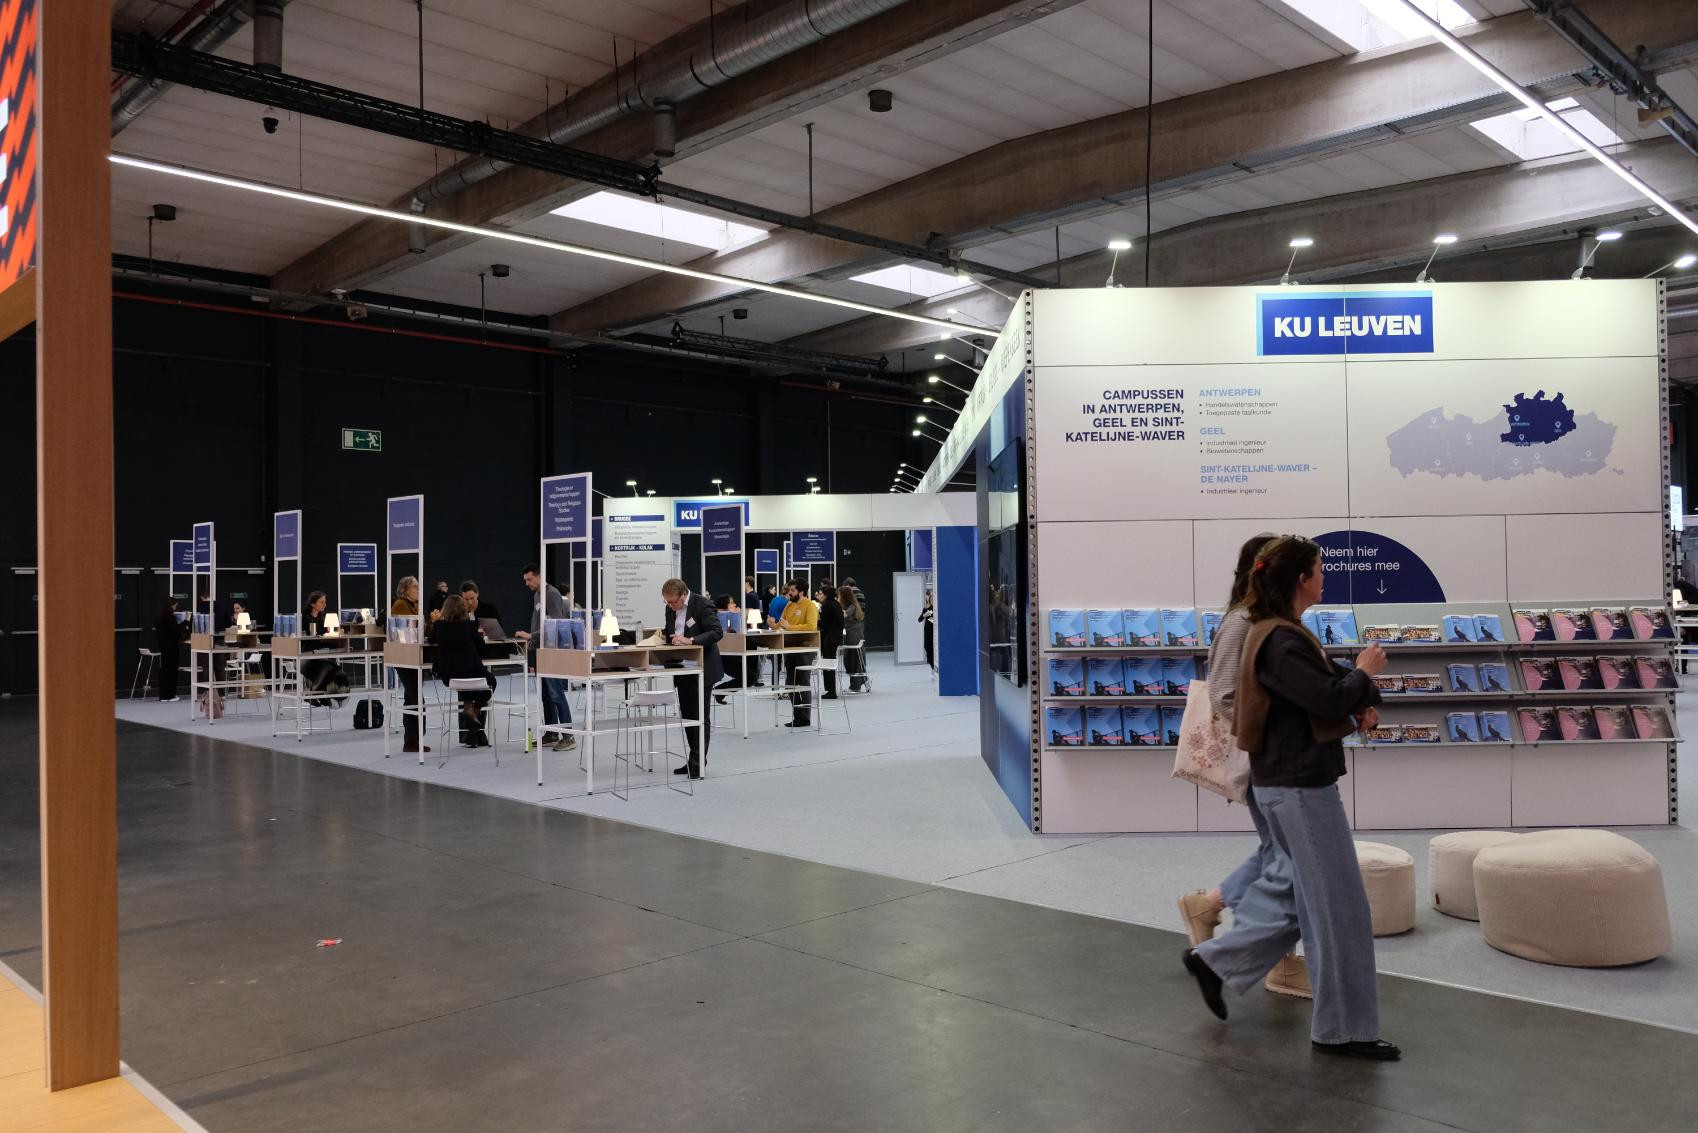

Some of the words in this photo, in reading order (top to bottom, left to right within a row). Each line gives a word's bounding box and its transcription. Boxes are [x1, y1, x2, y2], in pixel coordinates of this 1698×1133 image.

[1274, 316, 1312, 338] KU
[1318, 314, 1422, 337] LEUVEN
[1103, 389, 1184, 400] CAMPUSSEN
[1199, 388, 1261, 397] ANTWERPEN
[1082, 404, 1095, 414] IN
[1099, 403, 1184, 415] ANTWERPEN,
[1205, 401, 1278, 409] Handelswetenschappen
[1093, 417, 1127, 428] GEEL
[1131, 417, 1148, 427] EN
[1152, 416, 1185, 427] SINT-
[1065, 430, 1185, 442] KATELIJNE-WAVER
[1199, 427, 1226, 435] GEEL
[1206, 447, 1264, 455] Biowetenschappen
[1200, 464, 1310, 473] SINT-KATELIJNE-WAVER
[1216, 475, 1249, 483] NAYER
[681, 510, 698, 520] KU
[1320, 547, 1353, 557] Neem
[1357, 546, 1379, 557] hier
[1322, 561, 1372, 572] rochures
[1375, 561, 1400, 570] mee
